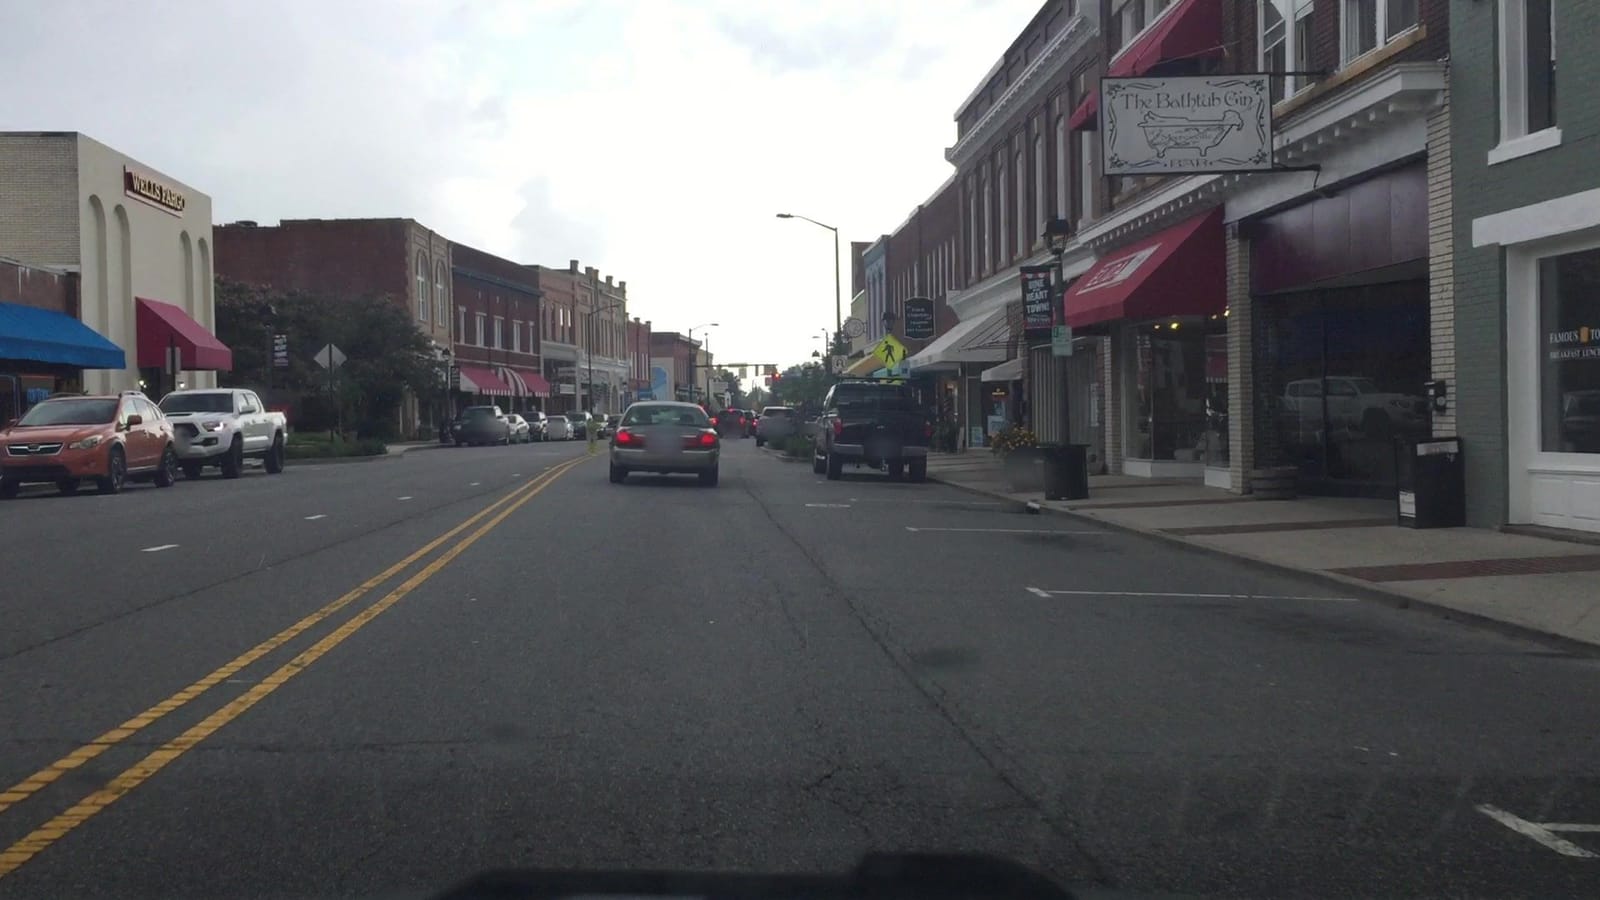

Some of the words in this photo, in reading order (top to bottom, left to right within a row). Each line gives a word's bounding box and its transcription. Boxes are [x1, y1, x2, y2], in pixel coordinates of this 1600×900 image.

[1120, 92, 1151, 111] The
[1156, 91, 1221, 111] Bathtub
[1224, 90, 1254, 112] Gin
[1169, 158, 1208, 169] BAR
[132, 173, 161, 201] WELLS
[161, 187, 185, 209] FARGO
[1549, 330, 1579, 344] FAMOUS
